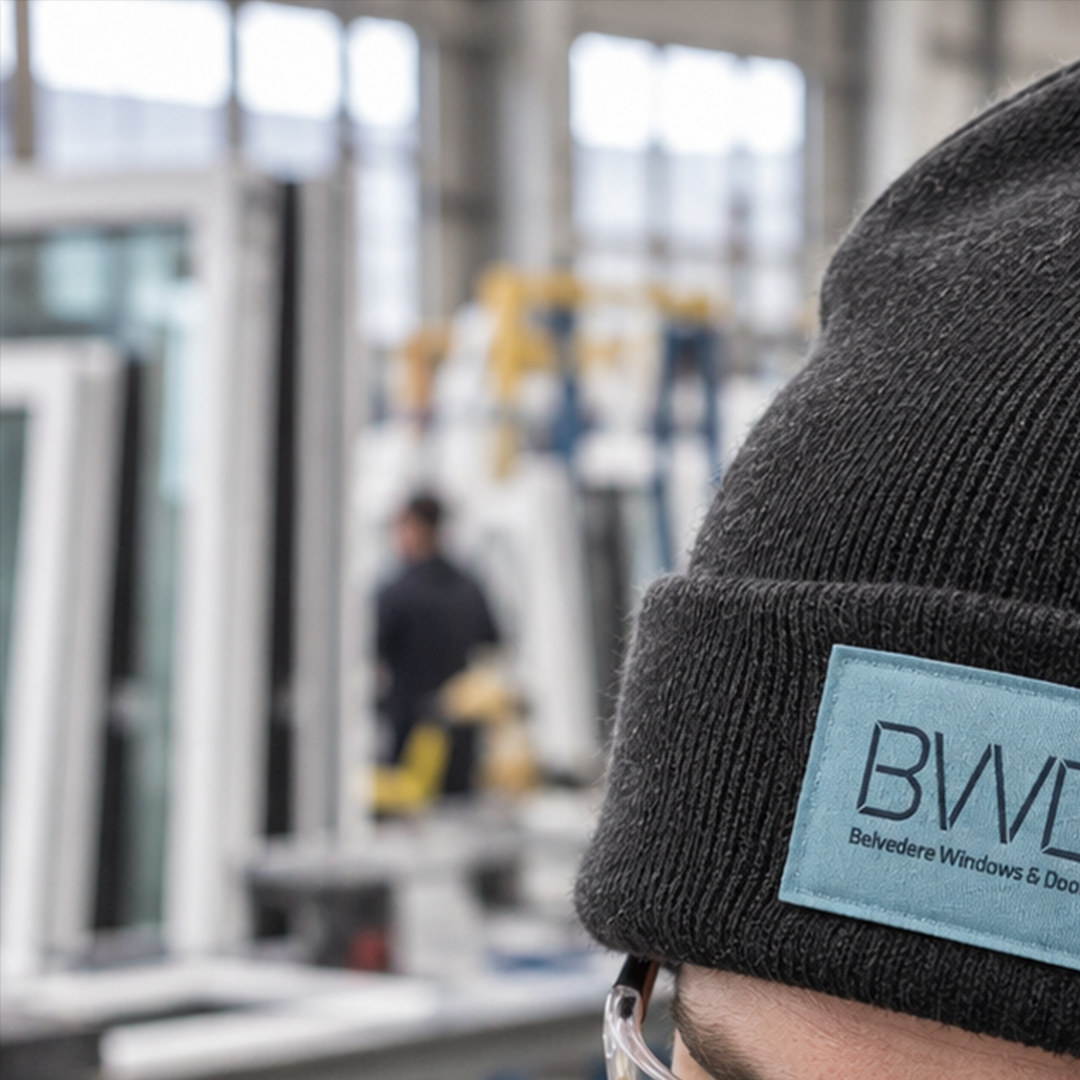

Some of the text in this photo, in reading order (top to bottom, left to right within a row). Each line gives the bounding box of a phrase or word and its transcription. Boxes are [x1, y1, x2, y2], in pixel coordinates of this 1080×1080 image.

[849, 827, 936, 861] Belvedere
[940, 845, 1023, 881] Windows
[1026, 867, 1041, 885] &
